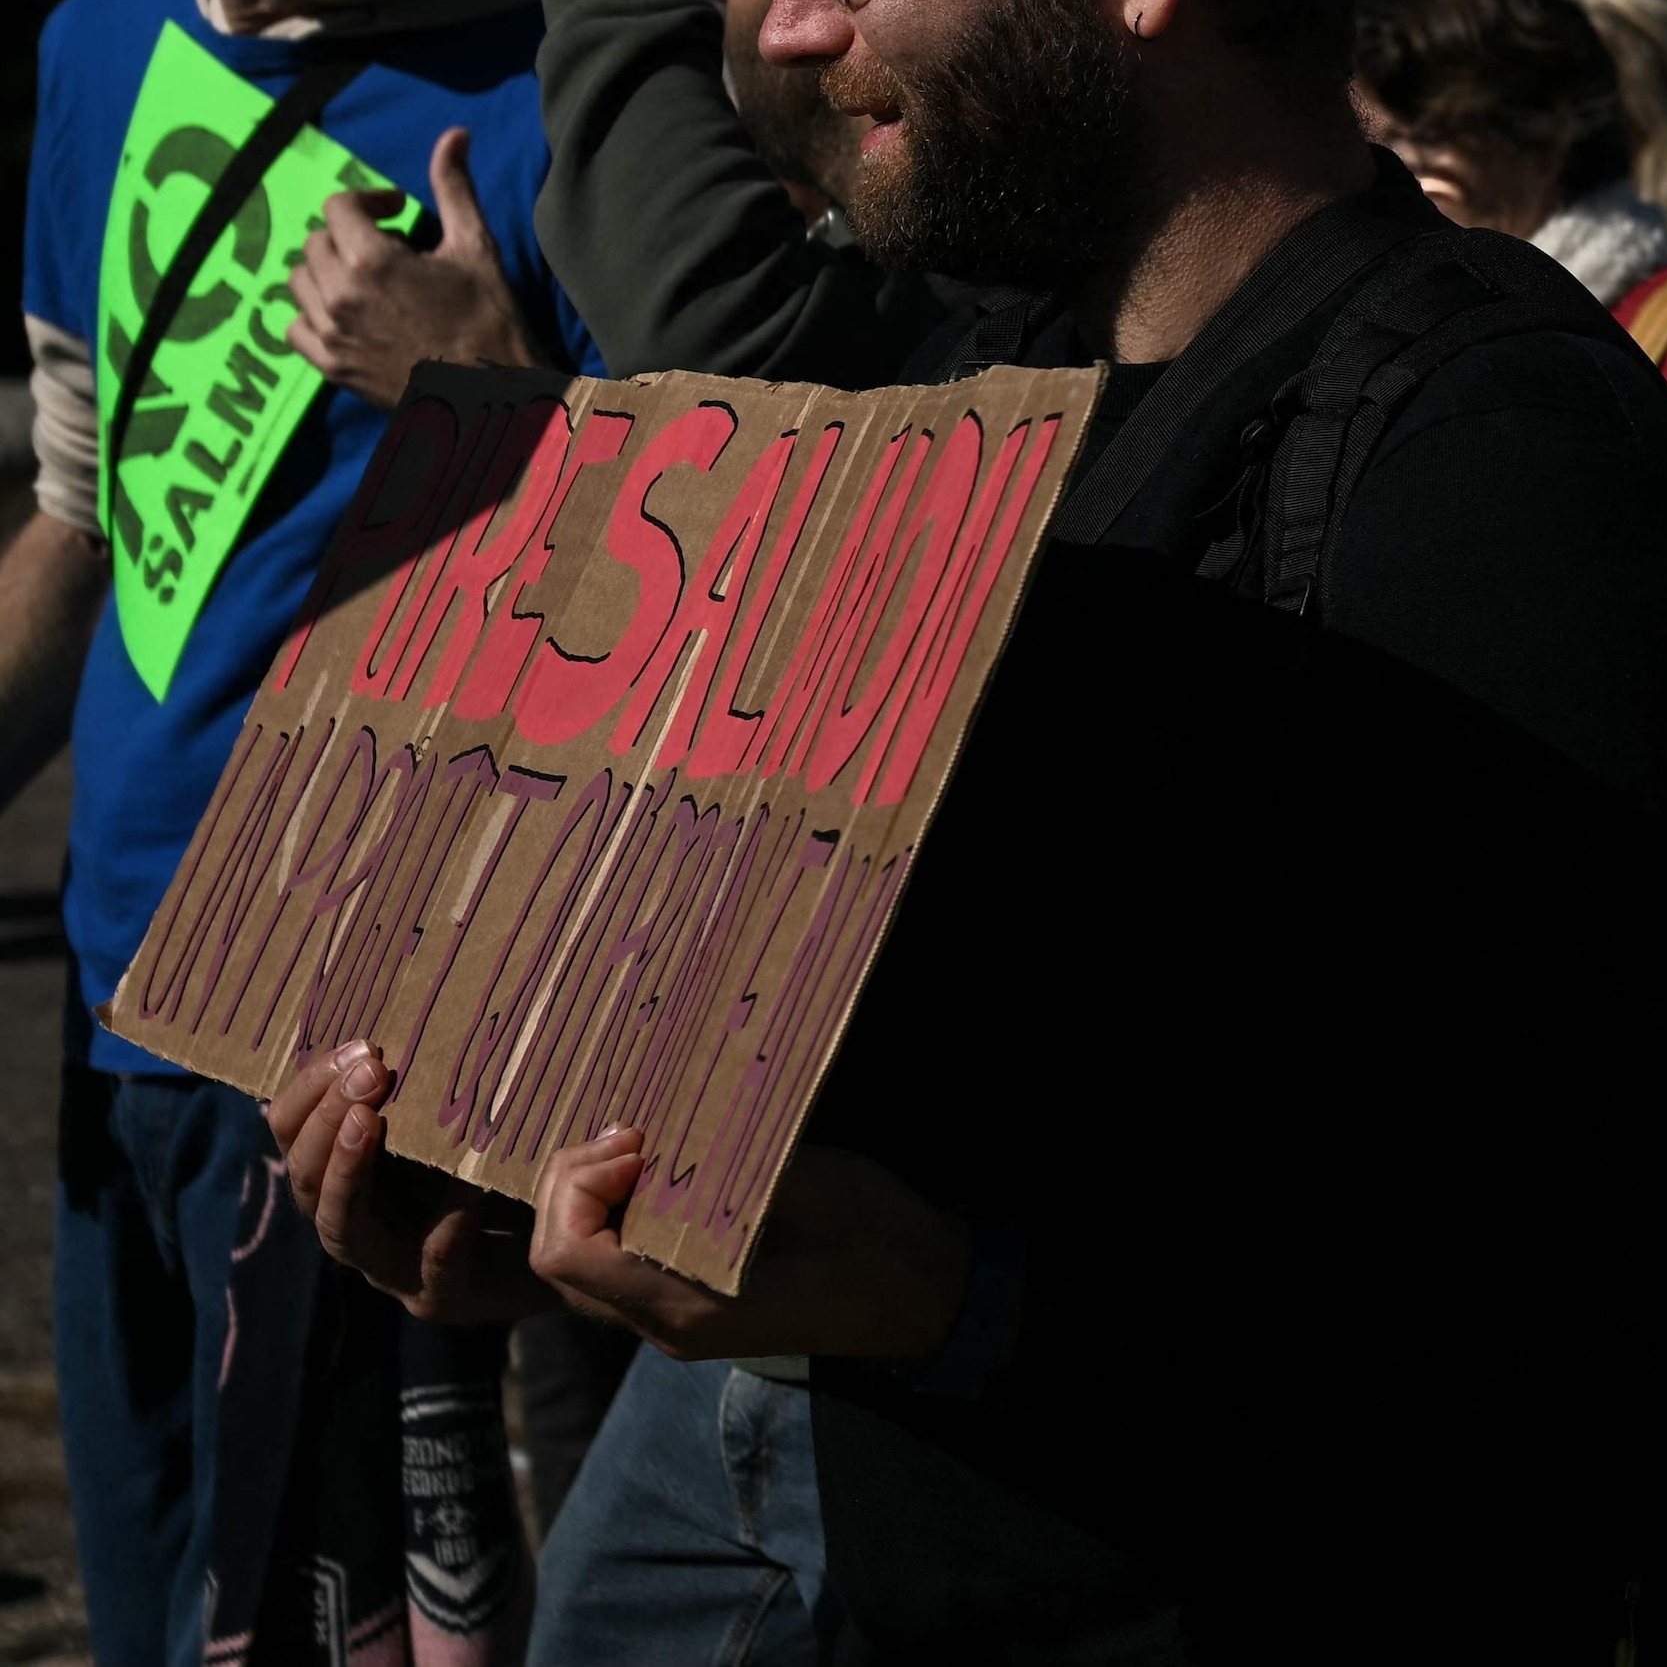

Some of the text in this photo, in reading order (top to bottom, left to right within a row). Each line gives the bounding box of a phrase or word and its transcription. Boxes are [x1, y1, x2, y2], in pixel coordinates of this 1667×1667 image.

[143, 210, 329, 604] SALMO
[273, 392, 1064, 807] PURE SALMON
[138, 716, 336, 1035] UN
[218, 723, 568, 1104] PROJET
[437, 766, 678, 1166] QUI
